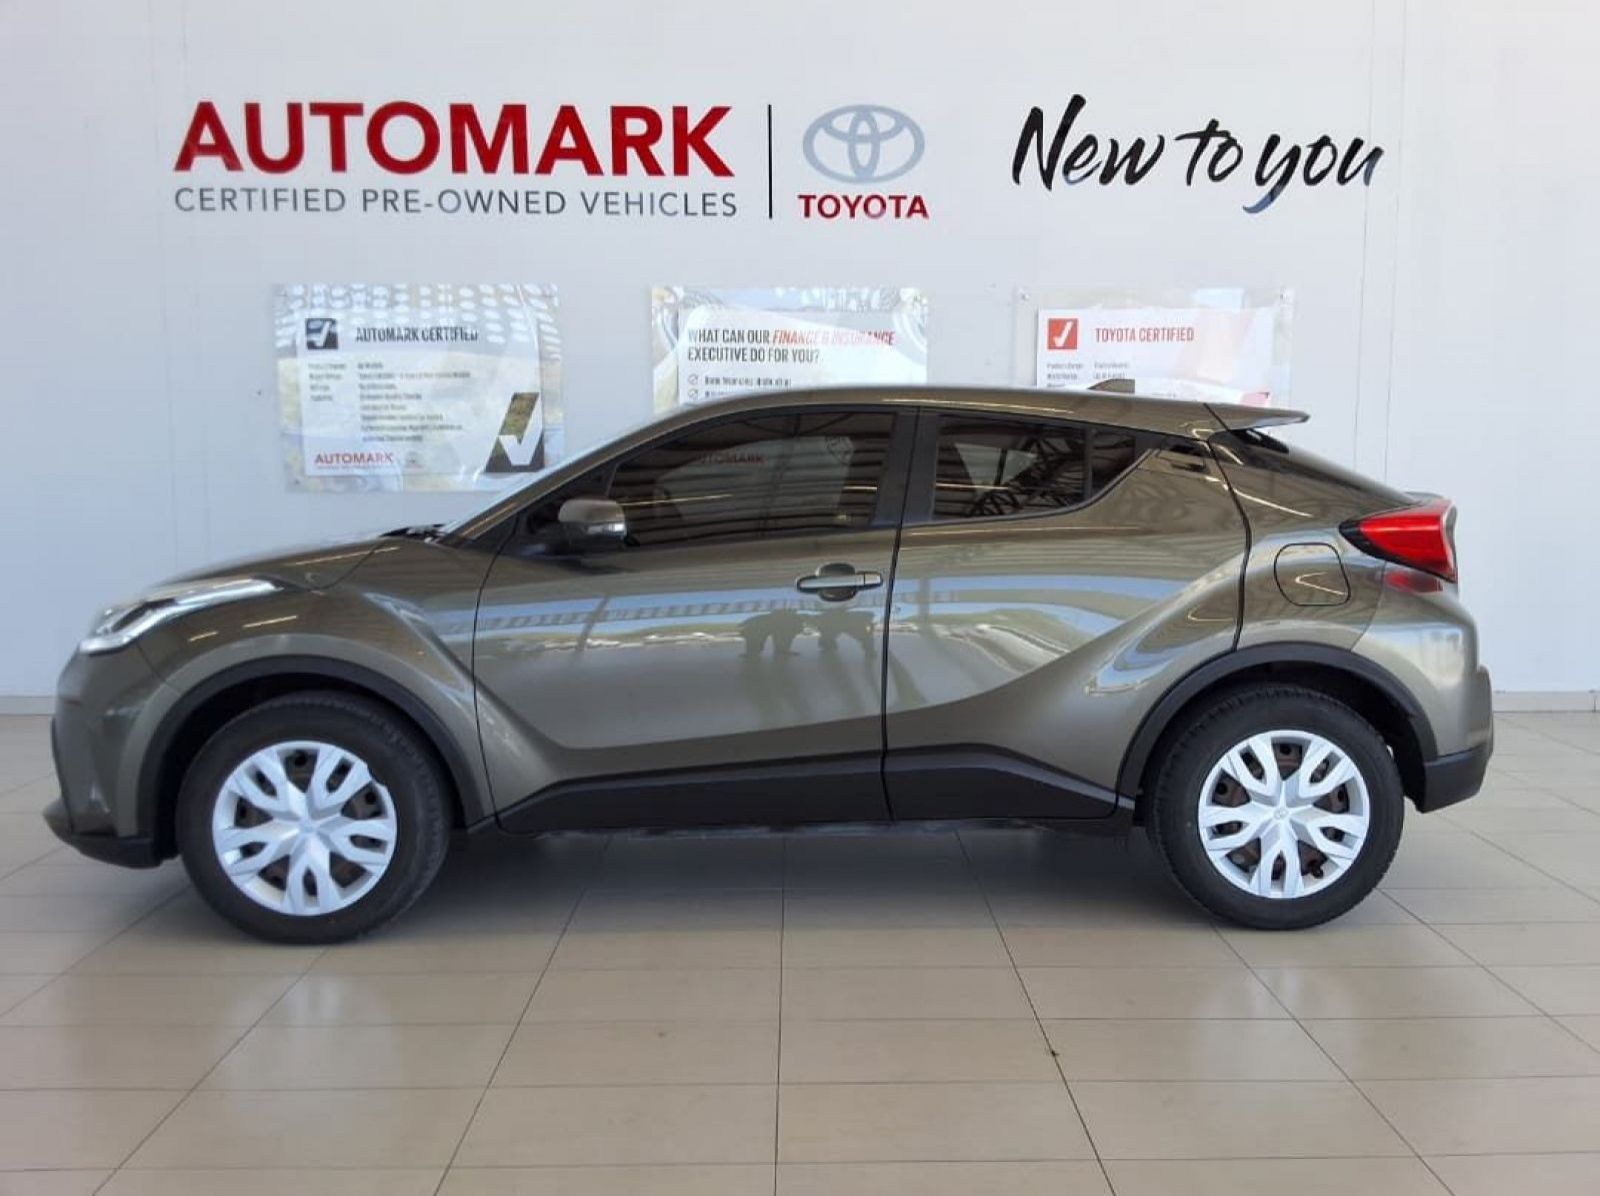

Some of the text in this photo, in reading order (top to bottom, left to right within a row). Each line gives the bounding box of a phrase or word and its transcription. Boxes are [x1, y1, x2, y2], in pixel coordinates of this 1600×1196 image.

[173, 101, 735, 177] AUTOMARK
[1012, 94, 1385, 214] New to you
[174, 187, 737, 217] CERTIFIED PRE-OWNED VEHICLES
[798, 194, 930, 220] TOYOTA
[356, 326, 478, 342] AUTOMARK CERTIFIED
[688, 329, 719, 344] WHAT
[722, 329, 745, 344] CAN
[747, 329, 770, 345] OUR
[1095, 326, 1195, 343] TOYOTA CERTIFIED
[688, 346, 820, 364] EXECUTIVE DO FOR YOU?
[315, 451, 394, 465] AUTOMARK
